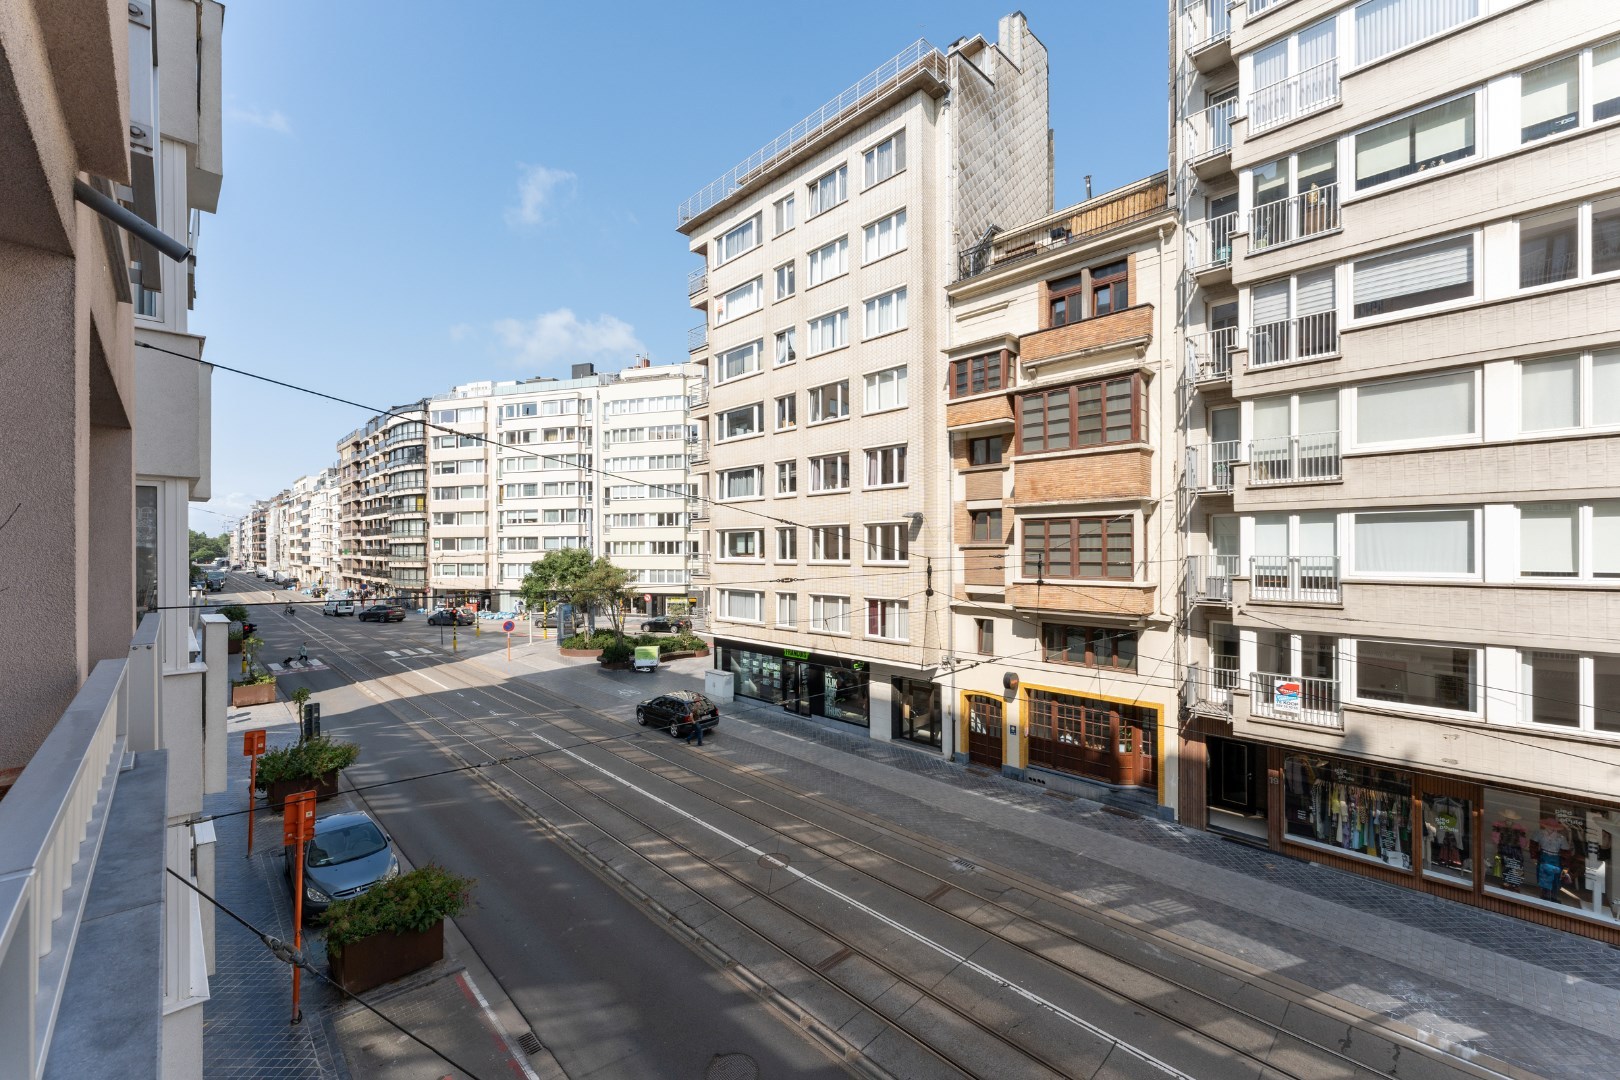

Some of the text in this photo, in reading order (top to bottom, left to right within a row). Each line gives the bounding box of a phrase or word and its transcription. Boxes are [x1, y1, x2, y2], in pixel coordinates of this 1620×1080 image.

[1268, 776, 1279, 785] 19
[1554, 808, 1573, 816] pied
[1434, 816, 1450, 824] pied
[1559, 817, 1584, 826] poule
[1439, 825, 1459, 833] poule
